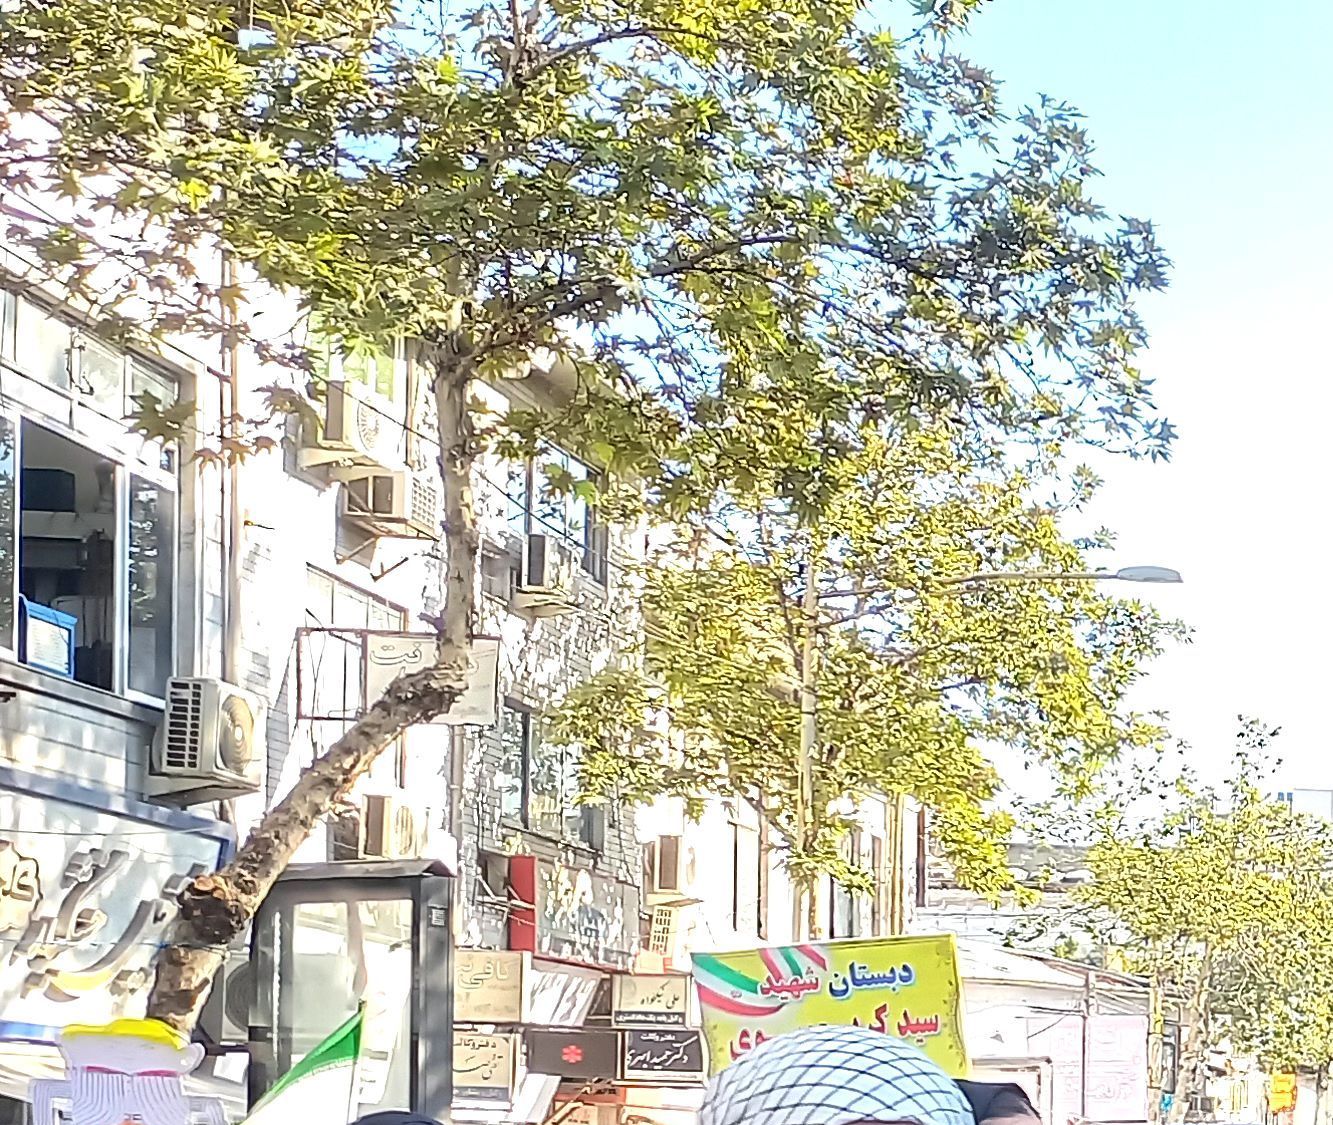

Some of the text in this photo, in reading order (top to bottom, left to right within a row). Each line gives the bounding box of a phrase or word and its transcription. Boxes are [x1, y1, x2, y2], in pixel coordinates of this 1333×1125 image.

[760, 962, 913, 1000] دبستان شهید
[898, 1010, 939, 1044] سید
